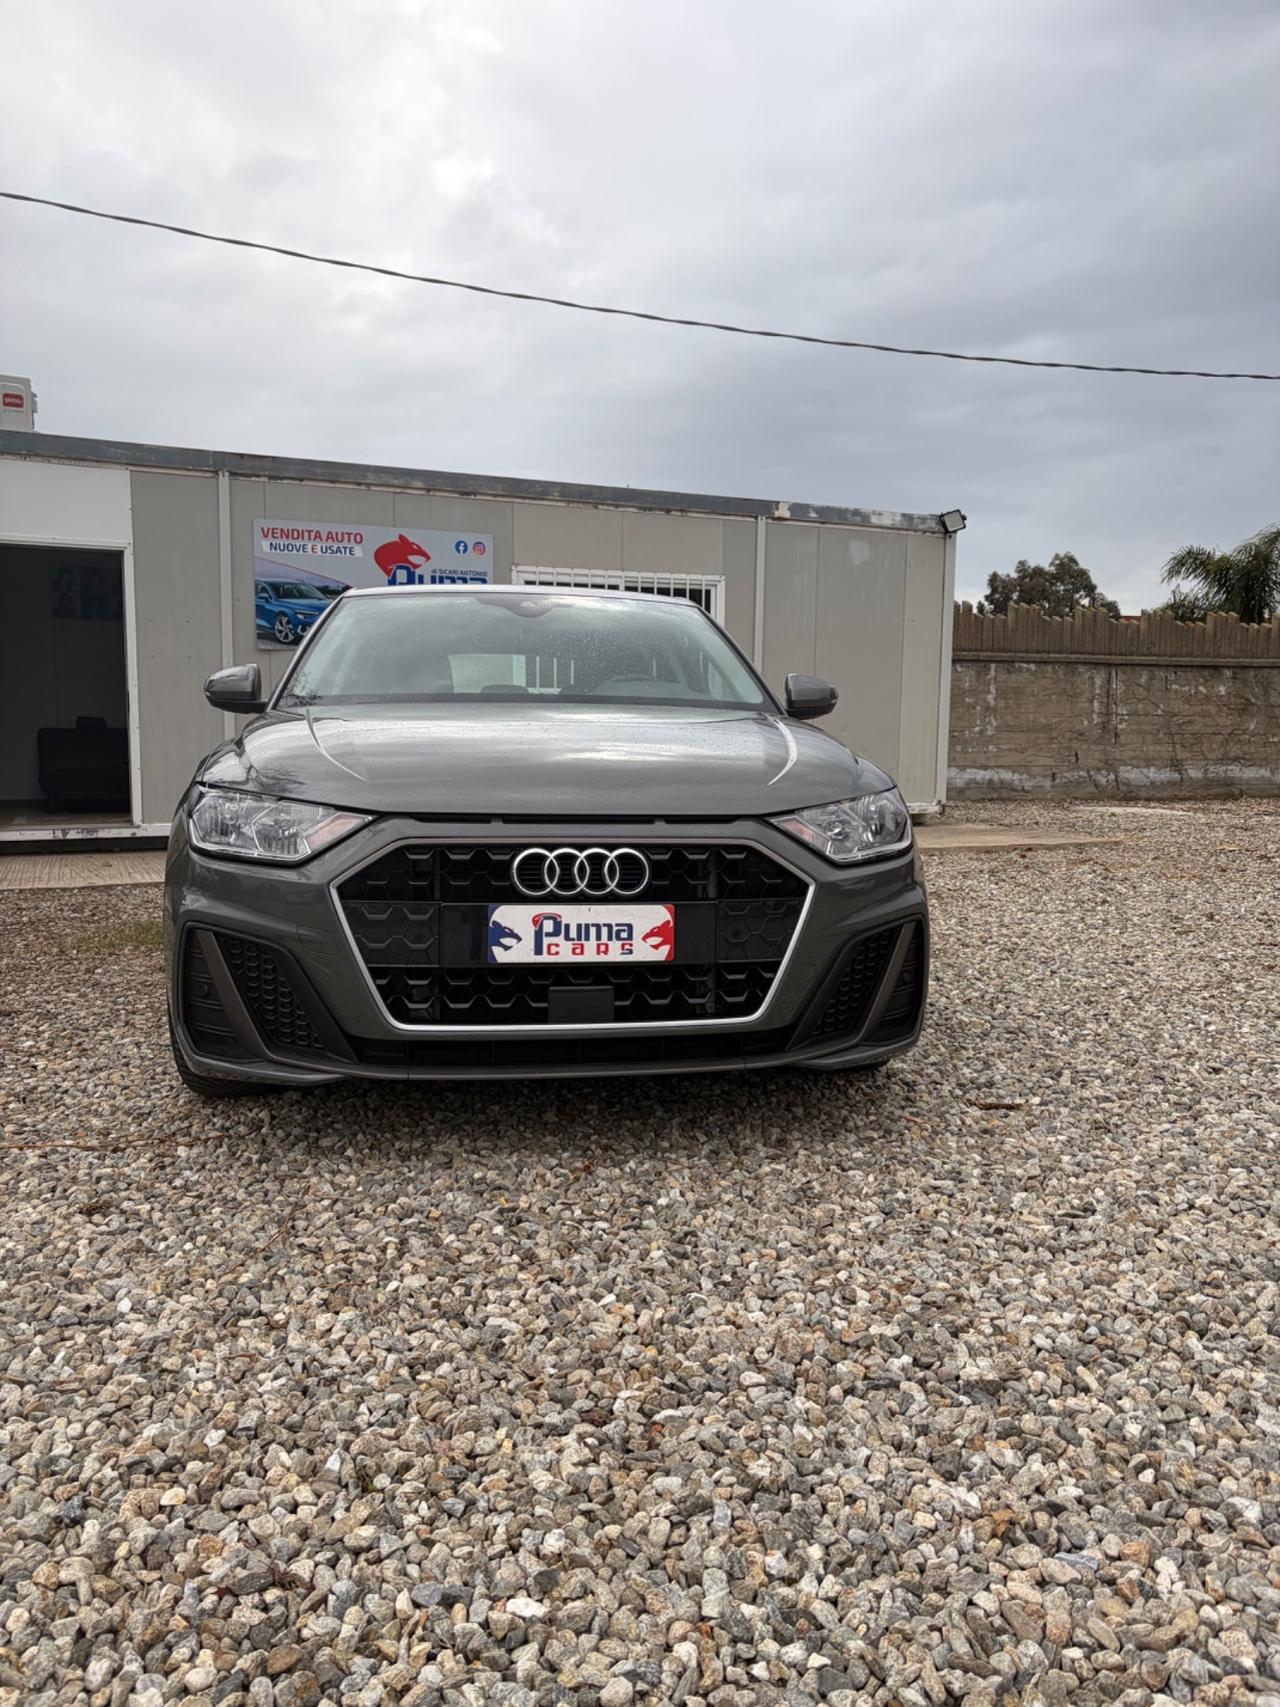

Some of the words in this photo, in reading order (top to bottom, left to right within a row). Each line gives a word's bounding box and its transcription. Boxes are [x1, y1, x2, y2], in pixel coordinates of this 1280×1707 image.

[260, 527, 323, 542] VENDITA
[325, 531, 363, 545] AUTO
[269, 542, 309, 554] NUOVE
[311, 543, 318, 554] E
[320, 545, 356, 556] USATE
[533, 912, 633, 956] Puma
